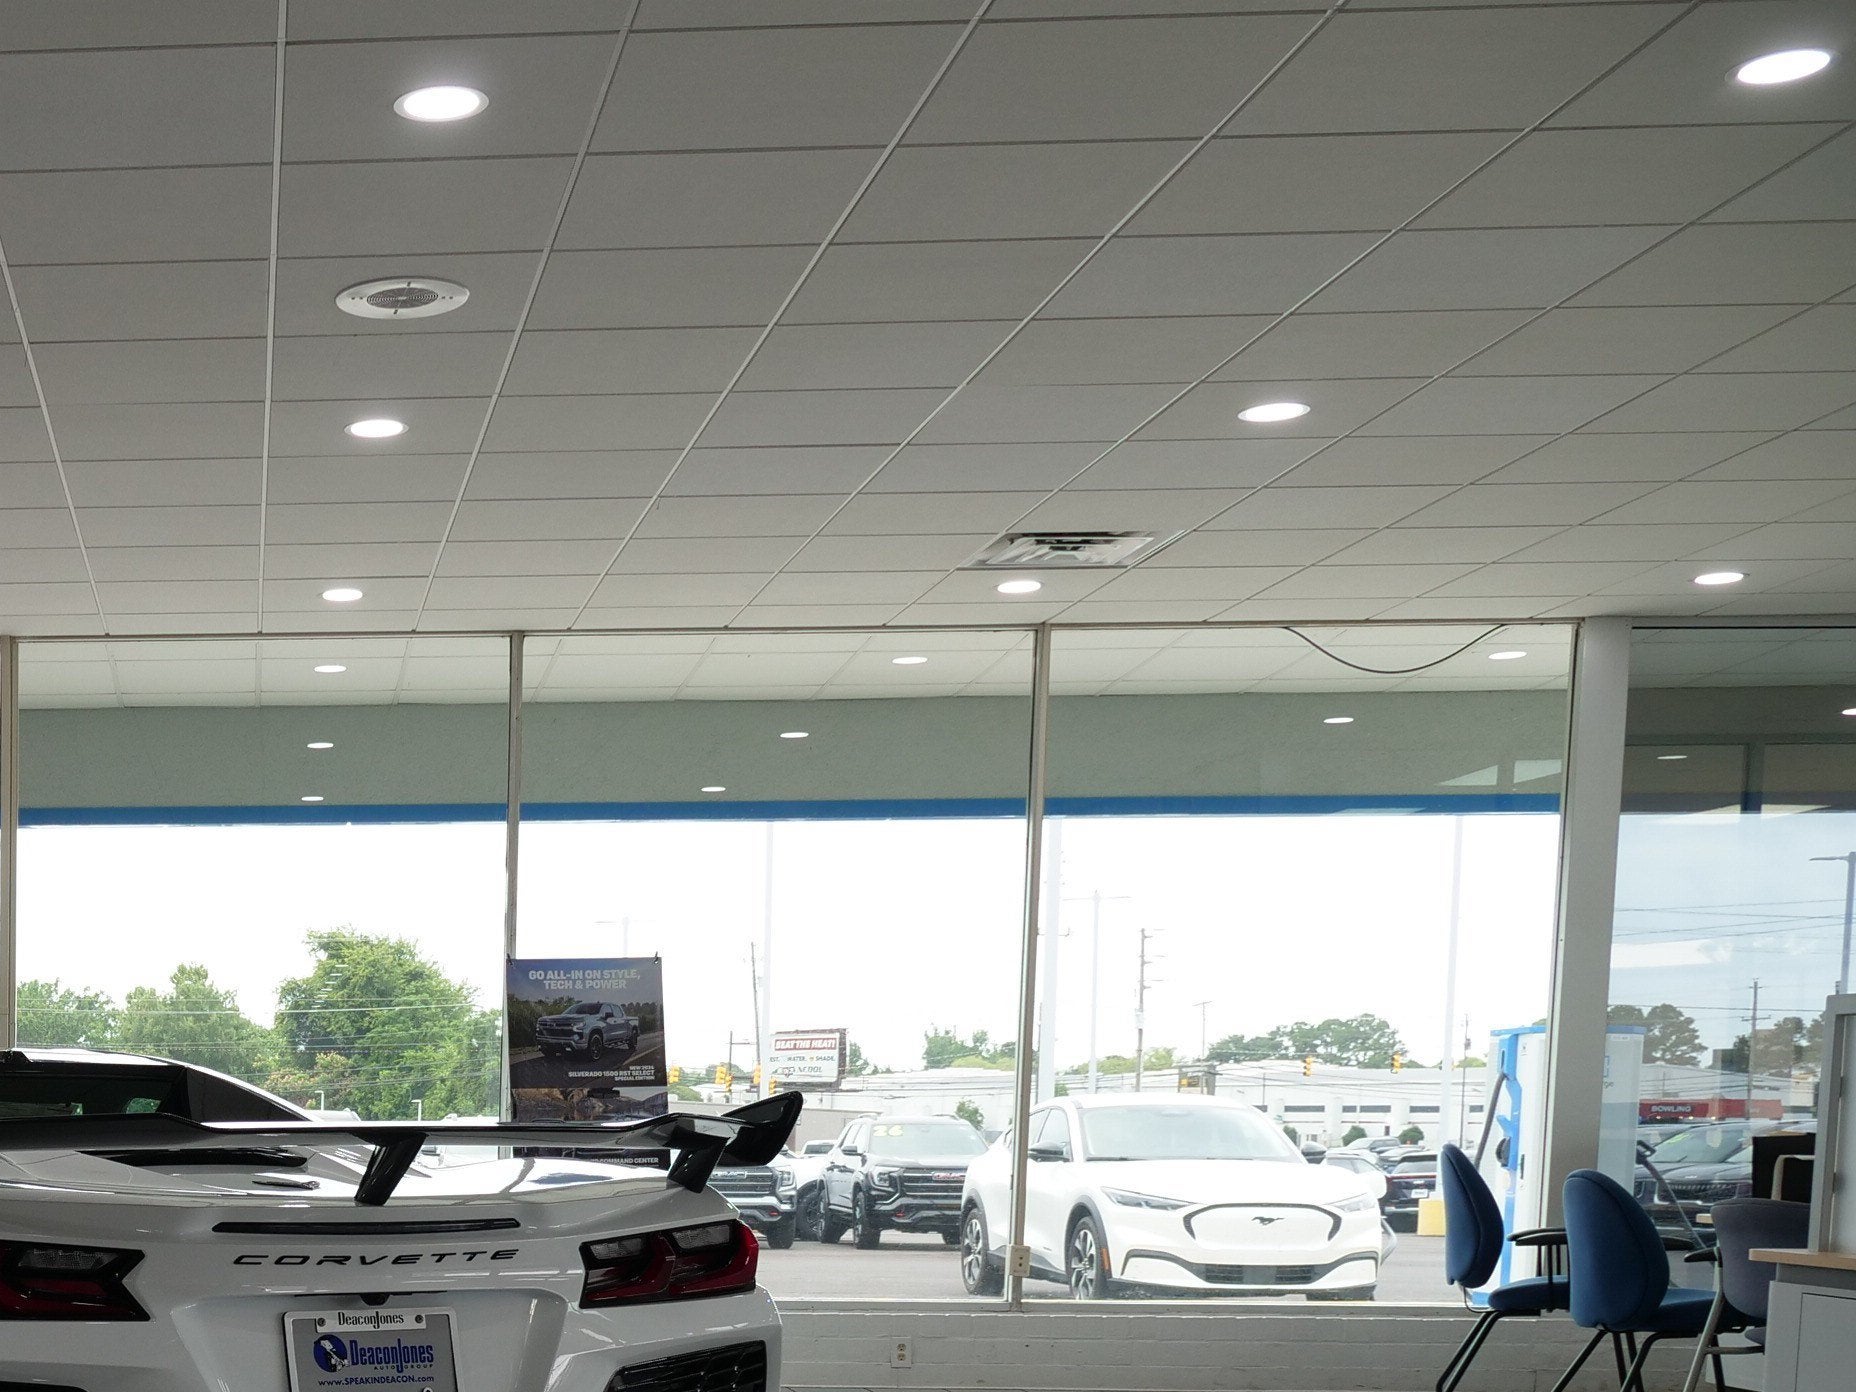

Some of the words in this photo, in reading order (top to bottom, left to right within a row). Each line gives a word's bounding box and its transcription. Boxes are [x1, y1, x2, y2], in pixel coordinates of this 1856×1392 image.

[528, 970, 545, 980] GO
[546, 970, 583, 980] ALL-IN
[585, 970, 601, 979] ON
[603, 969, 641, 980] STYLE,
[543, 980, 572, 989] TECH
[574, 980, 583, 989] &
[585, 980, 627, 989] POWER
[794, 1040, 811, 1049] THE
[1651, 1105, 1692, 1113] BOWLING
[872, 1124, 904, 1137] 26
[233, 1248, 520, 1267] CORVETTE
[318, 1374, 435, 1387] www.SPEAKINDEACON.com
